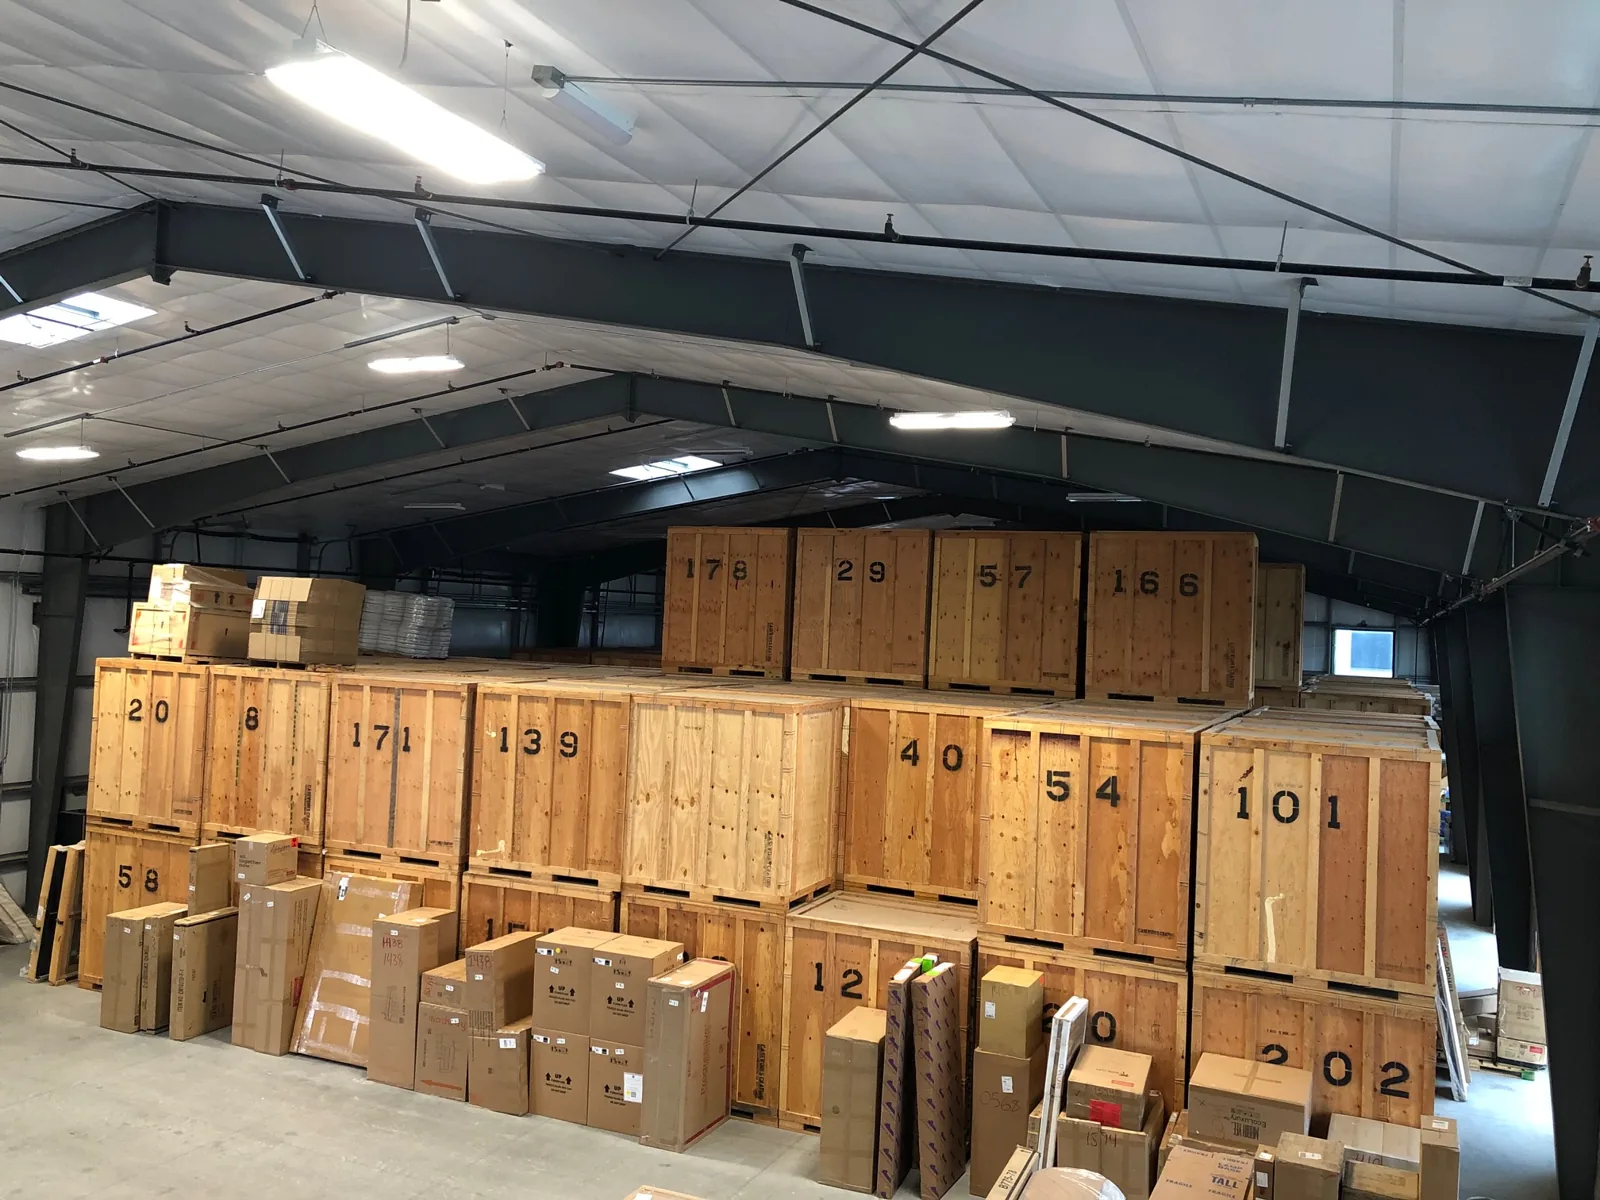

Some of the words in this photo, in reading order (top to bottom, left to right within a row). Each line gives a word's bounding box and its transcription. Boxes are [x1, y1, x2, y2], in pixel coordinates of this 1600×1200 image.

[837, 559, 886, 583] 29
[979, 564, 1033, 589] 57
[1114, 569, 1199, 597] 166
[128, 698, 169, 723] 20
[245, 706, 259, 731] 8
[352, 722, 411, 752] 171
[499, 726, 578, 758] 139
[900, 739, 964, 772] 40
[1046, 769, 1121, 808] 54
[1236, 786, 1341, 830] 101
[118, 864, 159, 893] 58
[814, 962, 863, 999] 12
[1211, 1175, 1240, 1189] TALL
